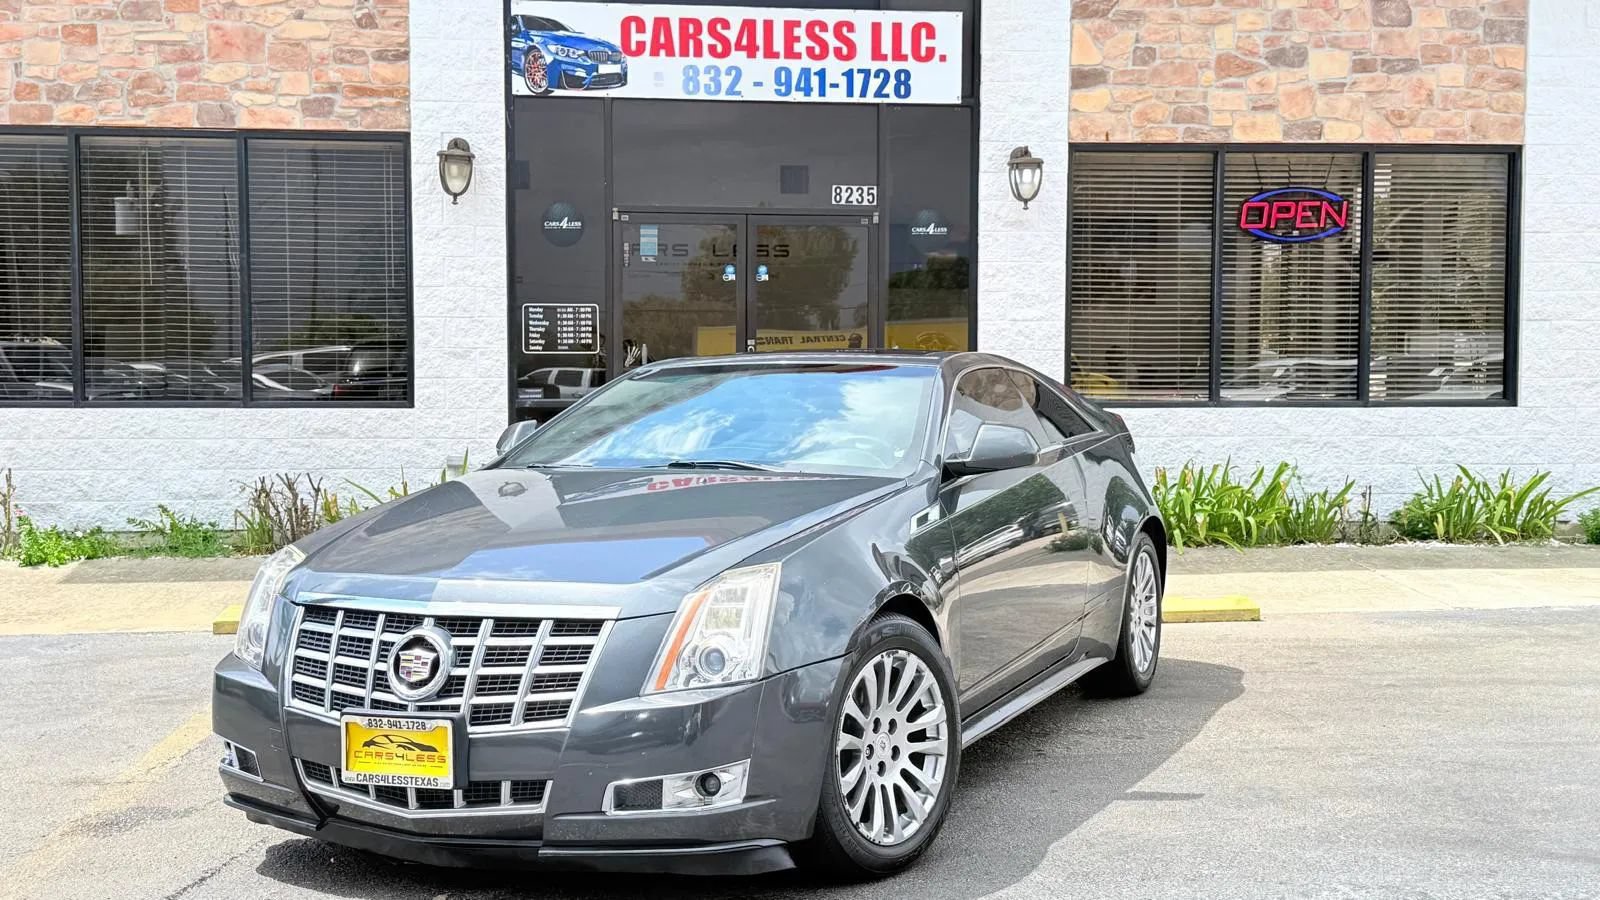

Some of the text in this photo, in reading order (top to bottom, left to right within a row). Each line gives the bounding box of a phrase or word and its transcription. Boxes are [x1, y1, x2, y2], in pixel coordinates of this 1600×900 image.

[620, 15, 947, 63] CARS4LESS LLC.
[682, 64, 743, 96] 832
[774, 66, 912, 99] 941-1728
[834, 186, 875, 204] 8235
[1240, 201, 1348, 229] OPEN
[367, 718, 427, 731] 832-941-1728
[354, 750, 446, 764] CARS4LESS
[356, 773, 439, 787] CARS4LESSTEXAS
